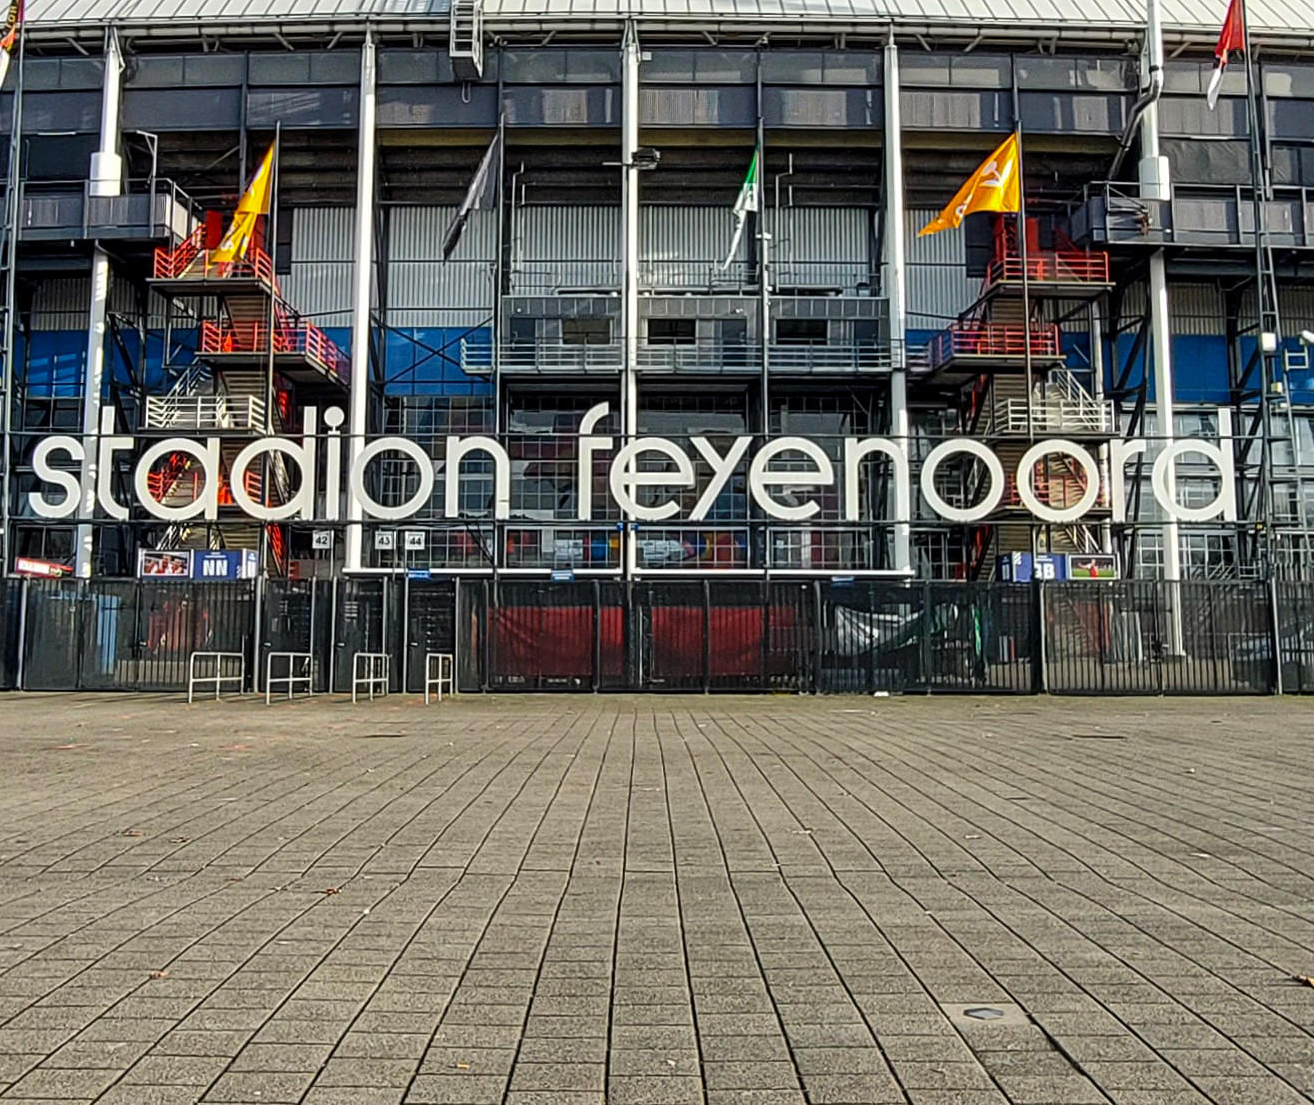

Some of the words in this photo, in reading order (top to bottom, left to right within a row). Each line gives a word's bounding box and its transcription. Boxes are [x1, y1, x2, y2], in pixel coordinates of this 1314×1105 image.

[29, 406, 510, 522] stadion
[577, 401, 1237, 523] feyenoord
[315, 536, 328, 546] 42
[378, 536, 391, 546] 43
[409, 536, 423, 546] 44
[203, 560, 227, 576] NN
